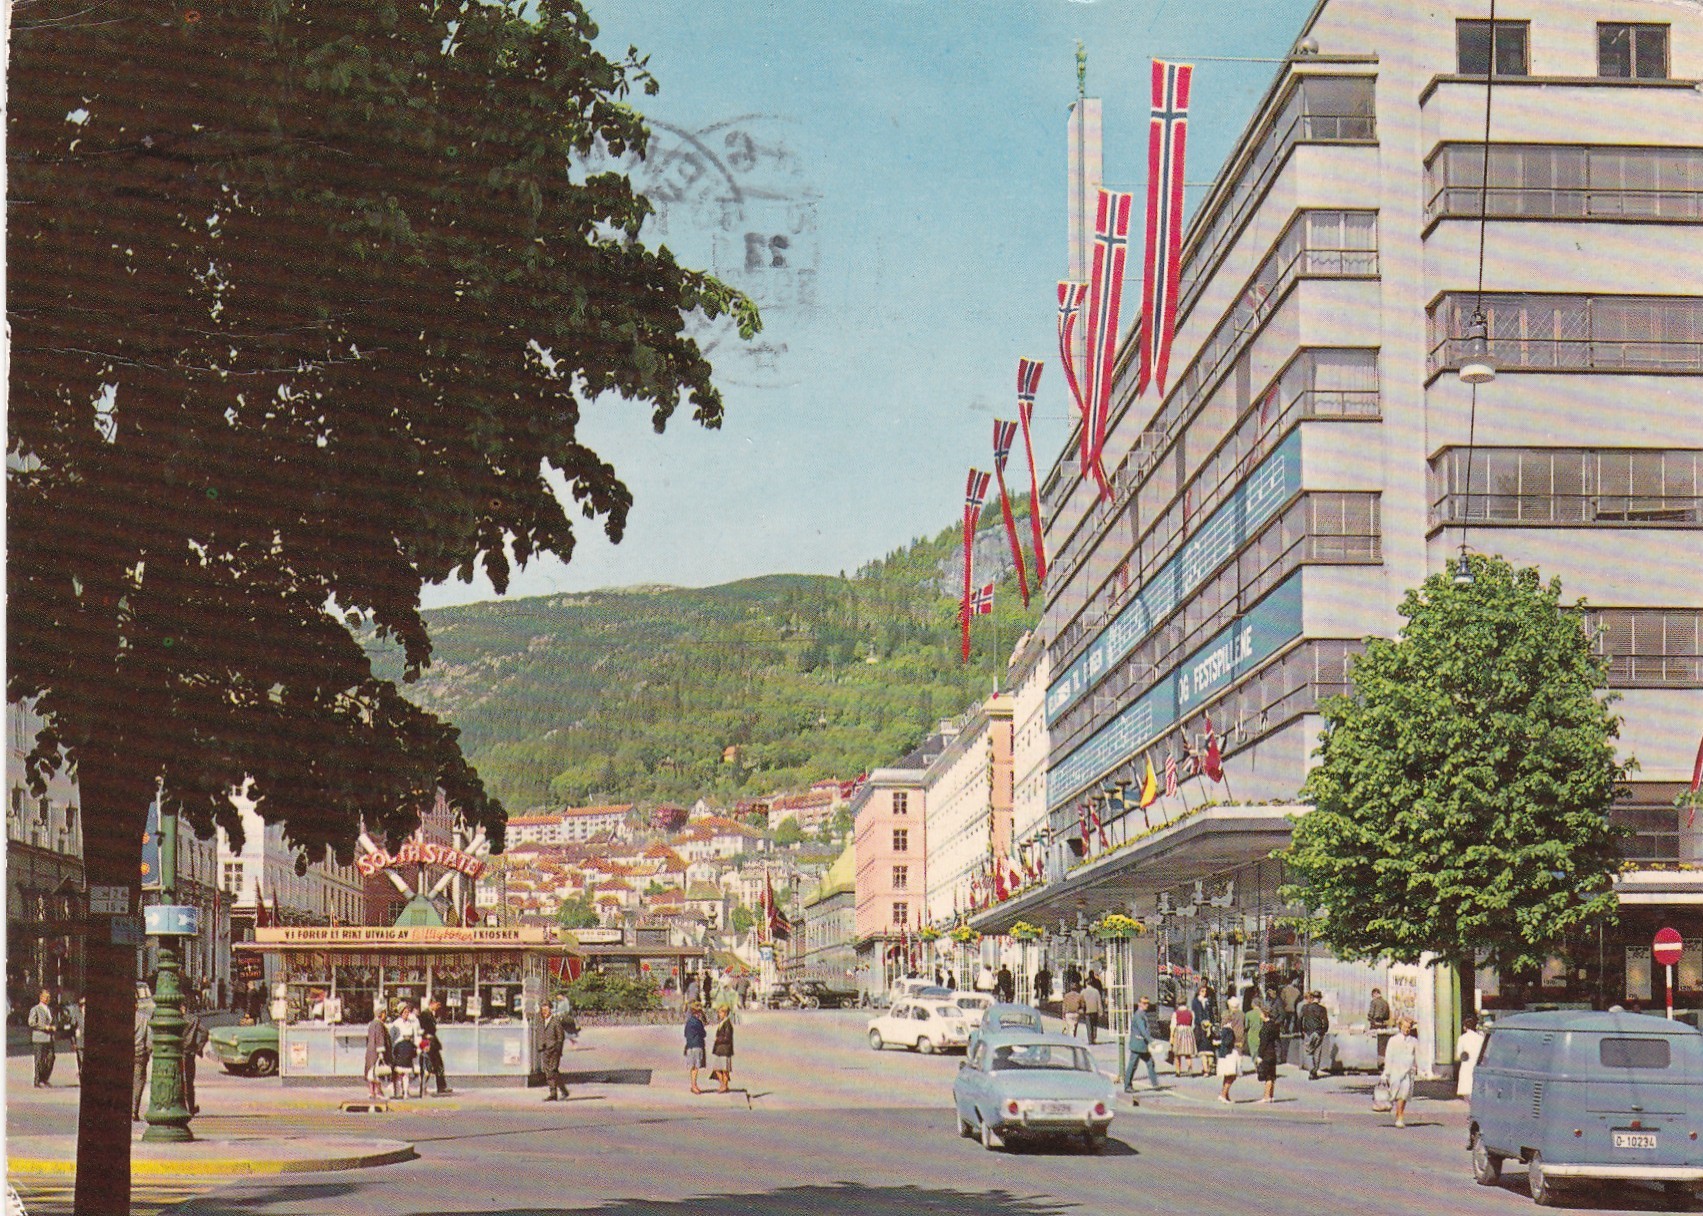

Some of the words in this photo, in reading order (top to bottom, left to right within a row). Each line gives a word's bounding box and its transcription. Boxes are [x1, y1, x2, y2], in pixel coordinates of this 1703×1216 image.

[1194, 625, 1252, 694] FESTSPILLENE
[423, 843, 480, 876] STATE
[285, 930, 295, 940] VI
[342, 930, 362, 940] RIKT
[365, 930, 396, 940] UTVALG
[398, 930, 409, 940] AV
[480, 930, 519, 940] KIOSKEN
